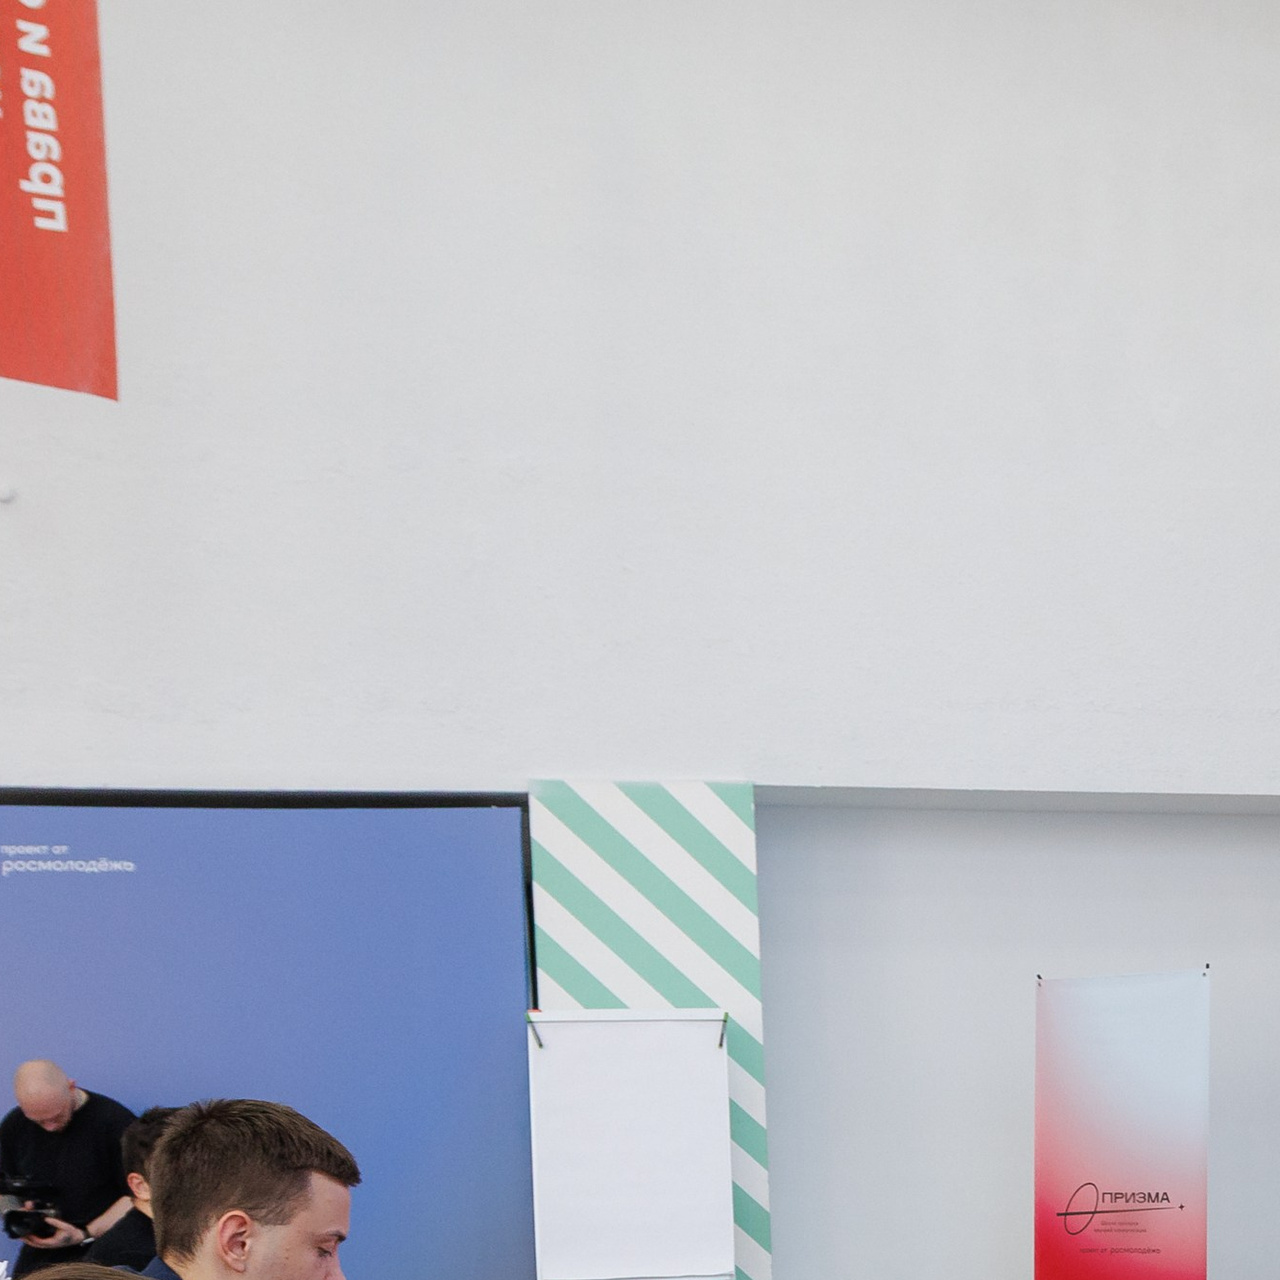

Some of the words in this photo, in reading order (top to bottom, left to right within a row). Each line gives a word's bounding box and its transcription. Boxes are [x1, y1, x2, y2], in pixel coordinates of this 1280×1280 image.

[51, 845, 69, 854] от
[2, 857, 136, 876] росмолодёжь
[1102, 1192, 1170, 1203] ПРИЗМА
